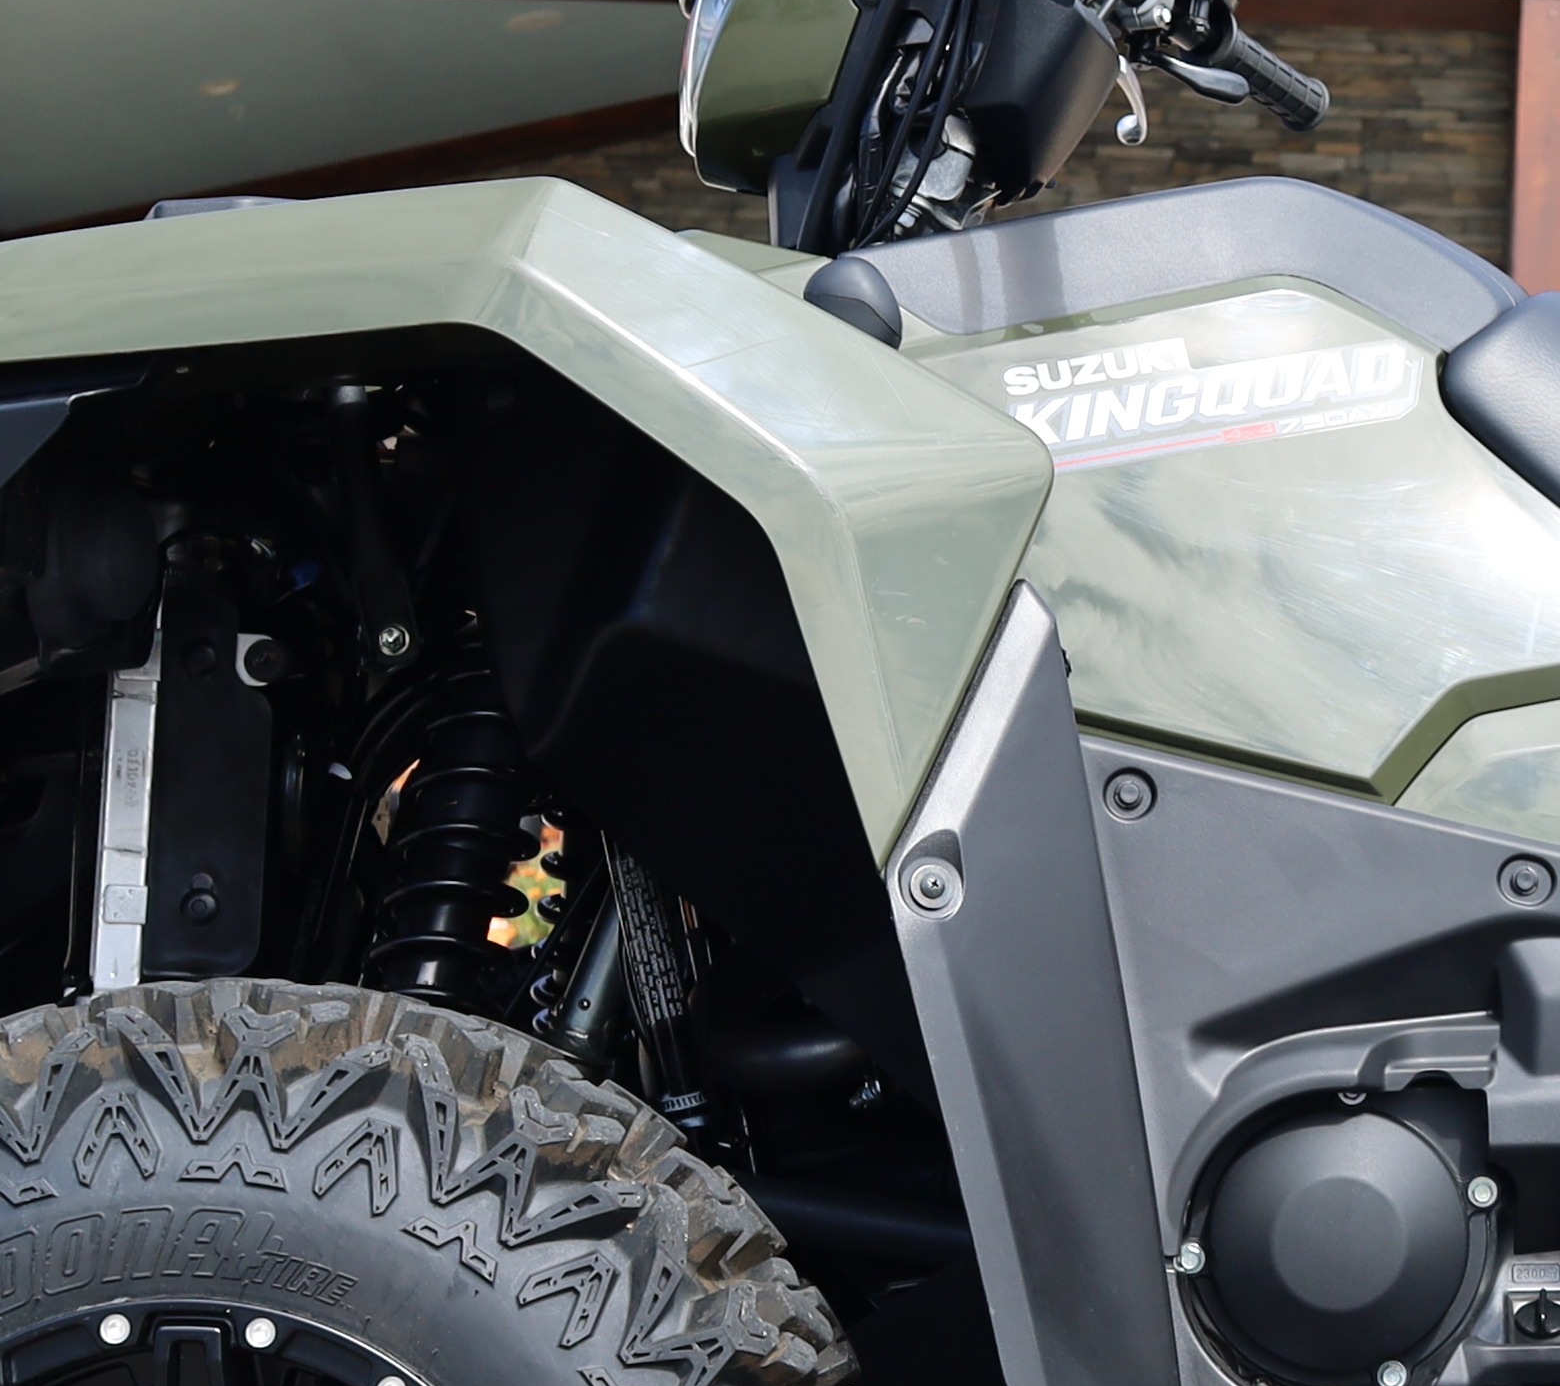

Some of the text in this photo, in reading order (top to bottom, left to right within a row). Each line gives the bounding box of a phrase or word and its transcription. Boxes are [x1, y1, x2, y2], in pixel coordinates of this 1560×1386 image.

[1002, 336, 1190, 397] SUZUKI
[1012, 344, 1408, 445] KINGQUAD
[257, 1251, 360, 1310] TIRE
